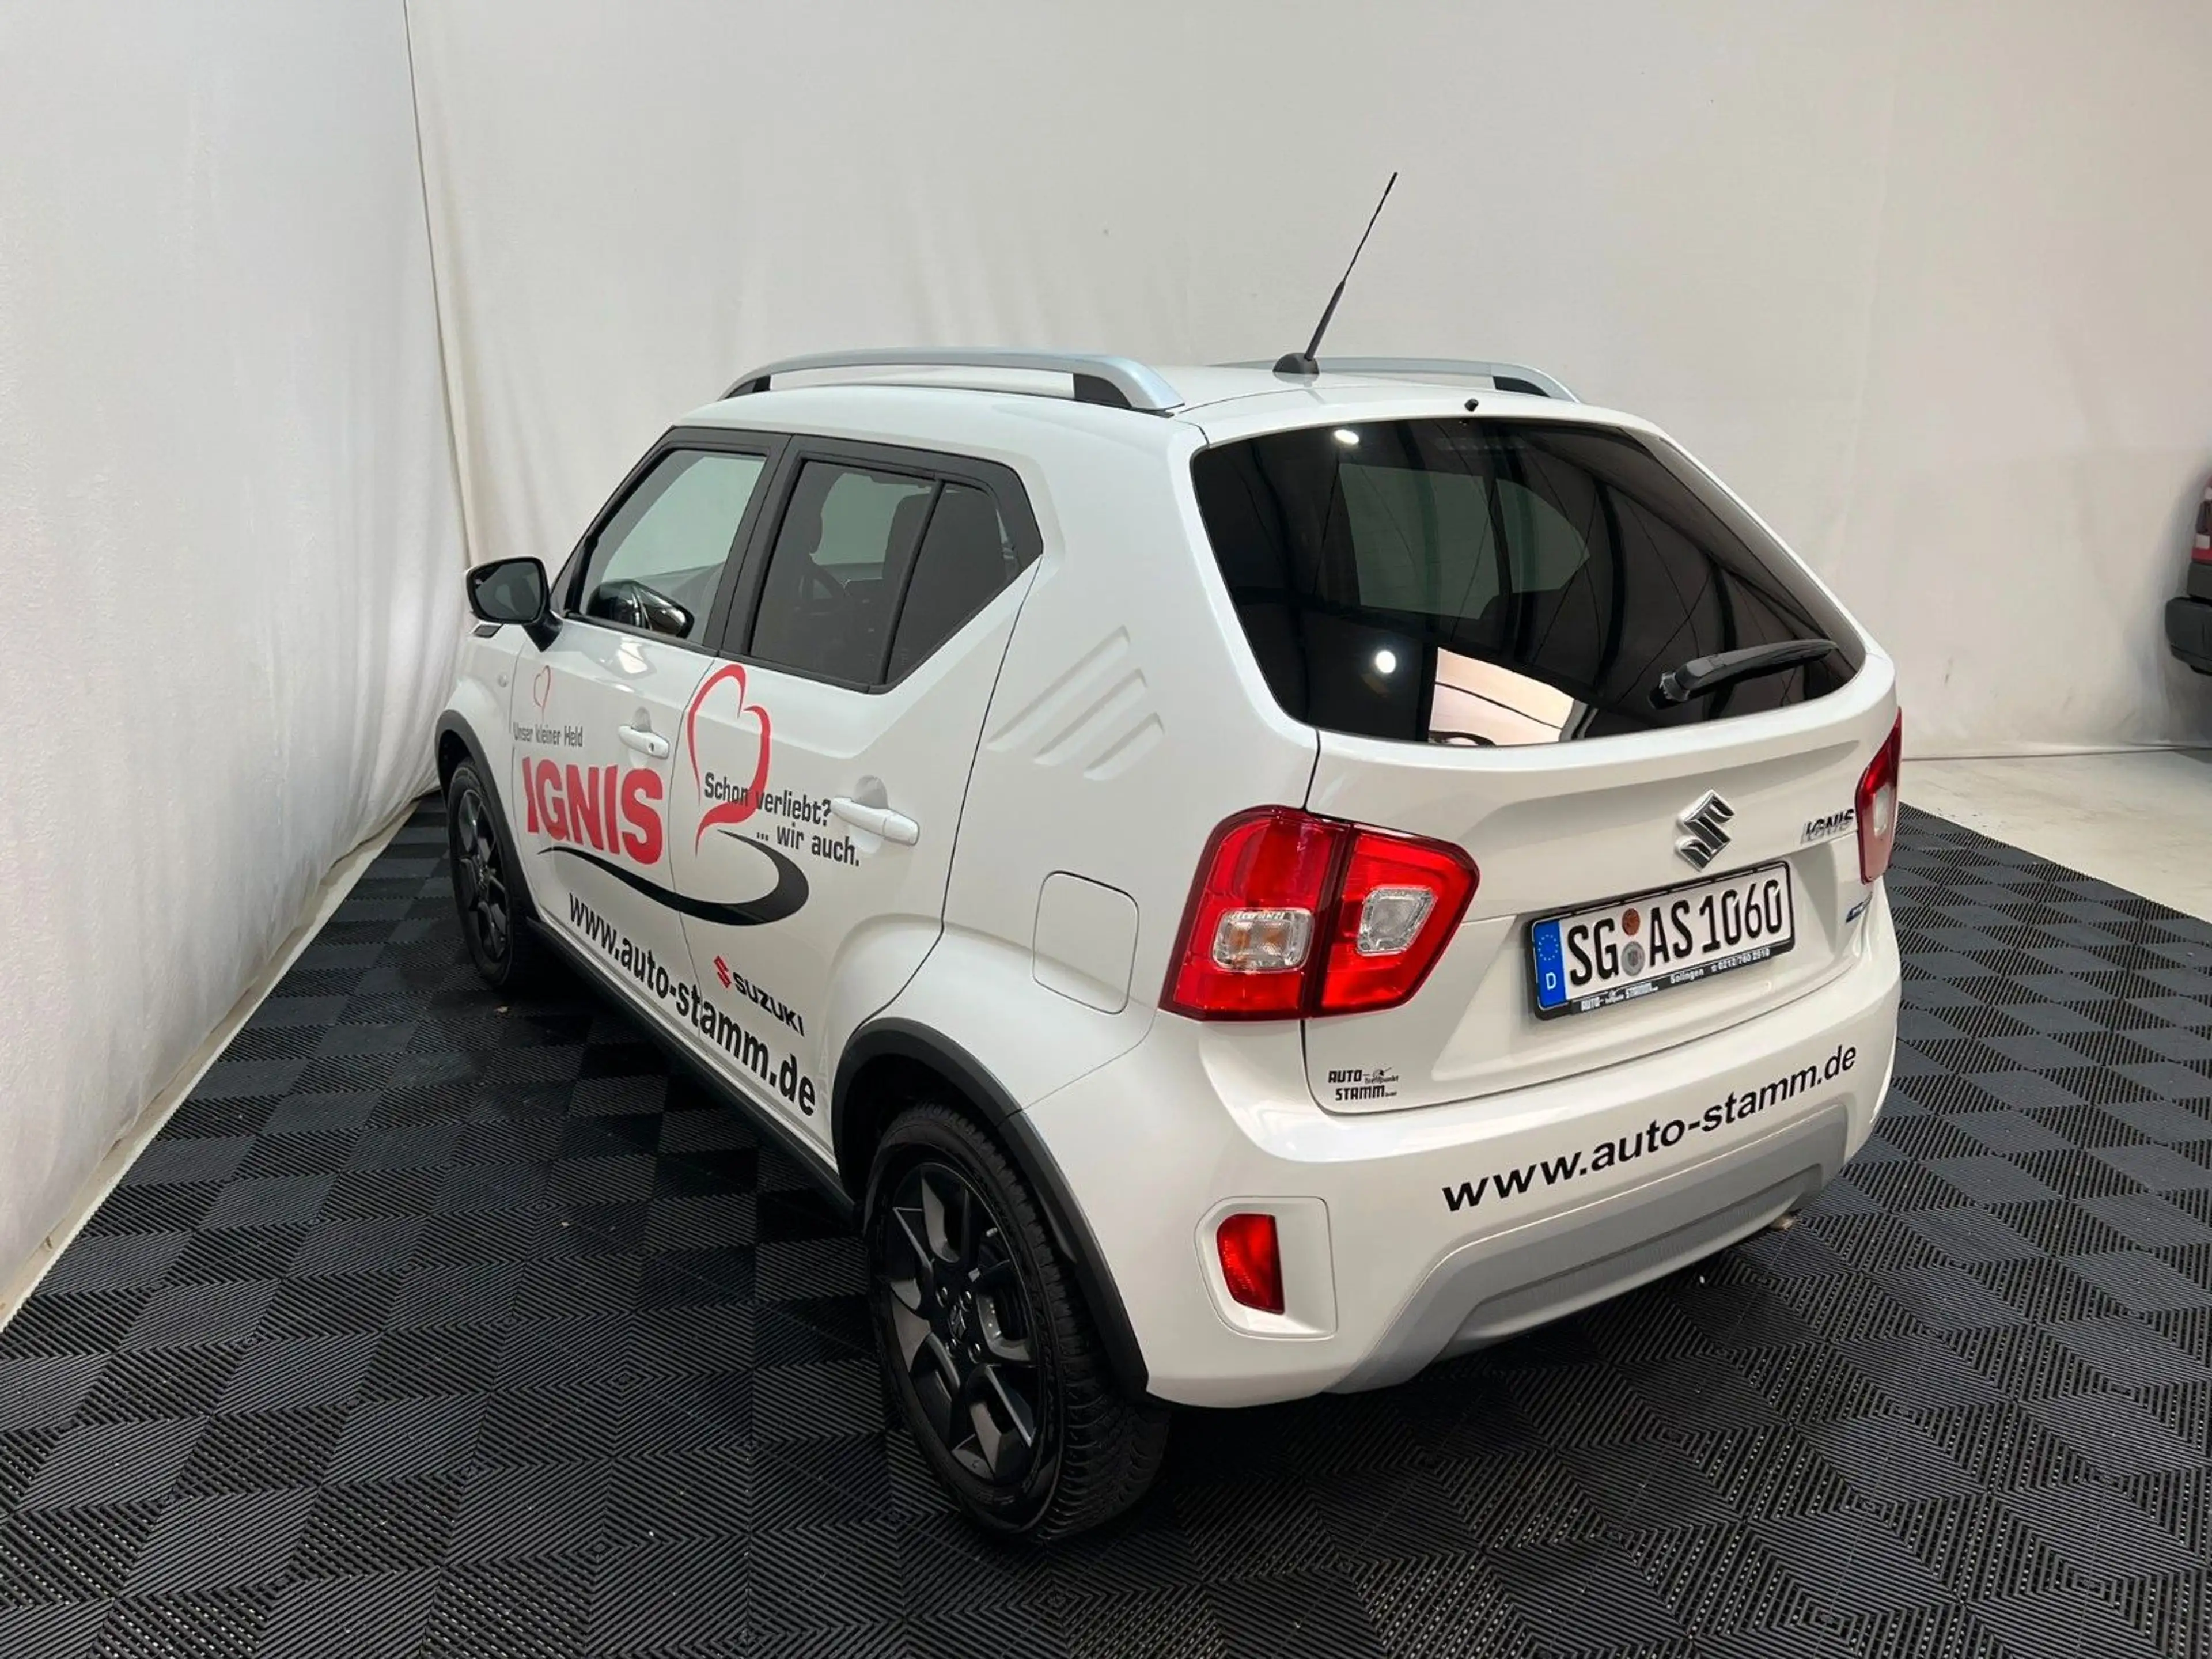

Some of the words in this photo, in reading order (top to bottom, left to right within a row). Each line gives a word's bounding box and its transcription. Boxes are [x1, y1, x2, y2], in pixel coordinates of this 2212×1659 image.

[522, 756, 663, 865] IGNIS
[704, 772, 749, 805] Schon
[756, 789, 832, 826] verliebt?
[777, 821, 804, 849] wir
[811, 836, 860, 866] auch.
[1546, 972, 1556, 990] D
[1567, 918, 1619, 986] SG
[569, 892, 816, 1117] www.auto-stamm.de
[732, 971, 805, 1037] SUZUKI
[1335, 1085, 1385, 1101] STAMM
[1442, 1044, 1857, 1213] www.auto-stamm.de
